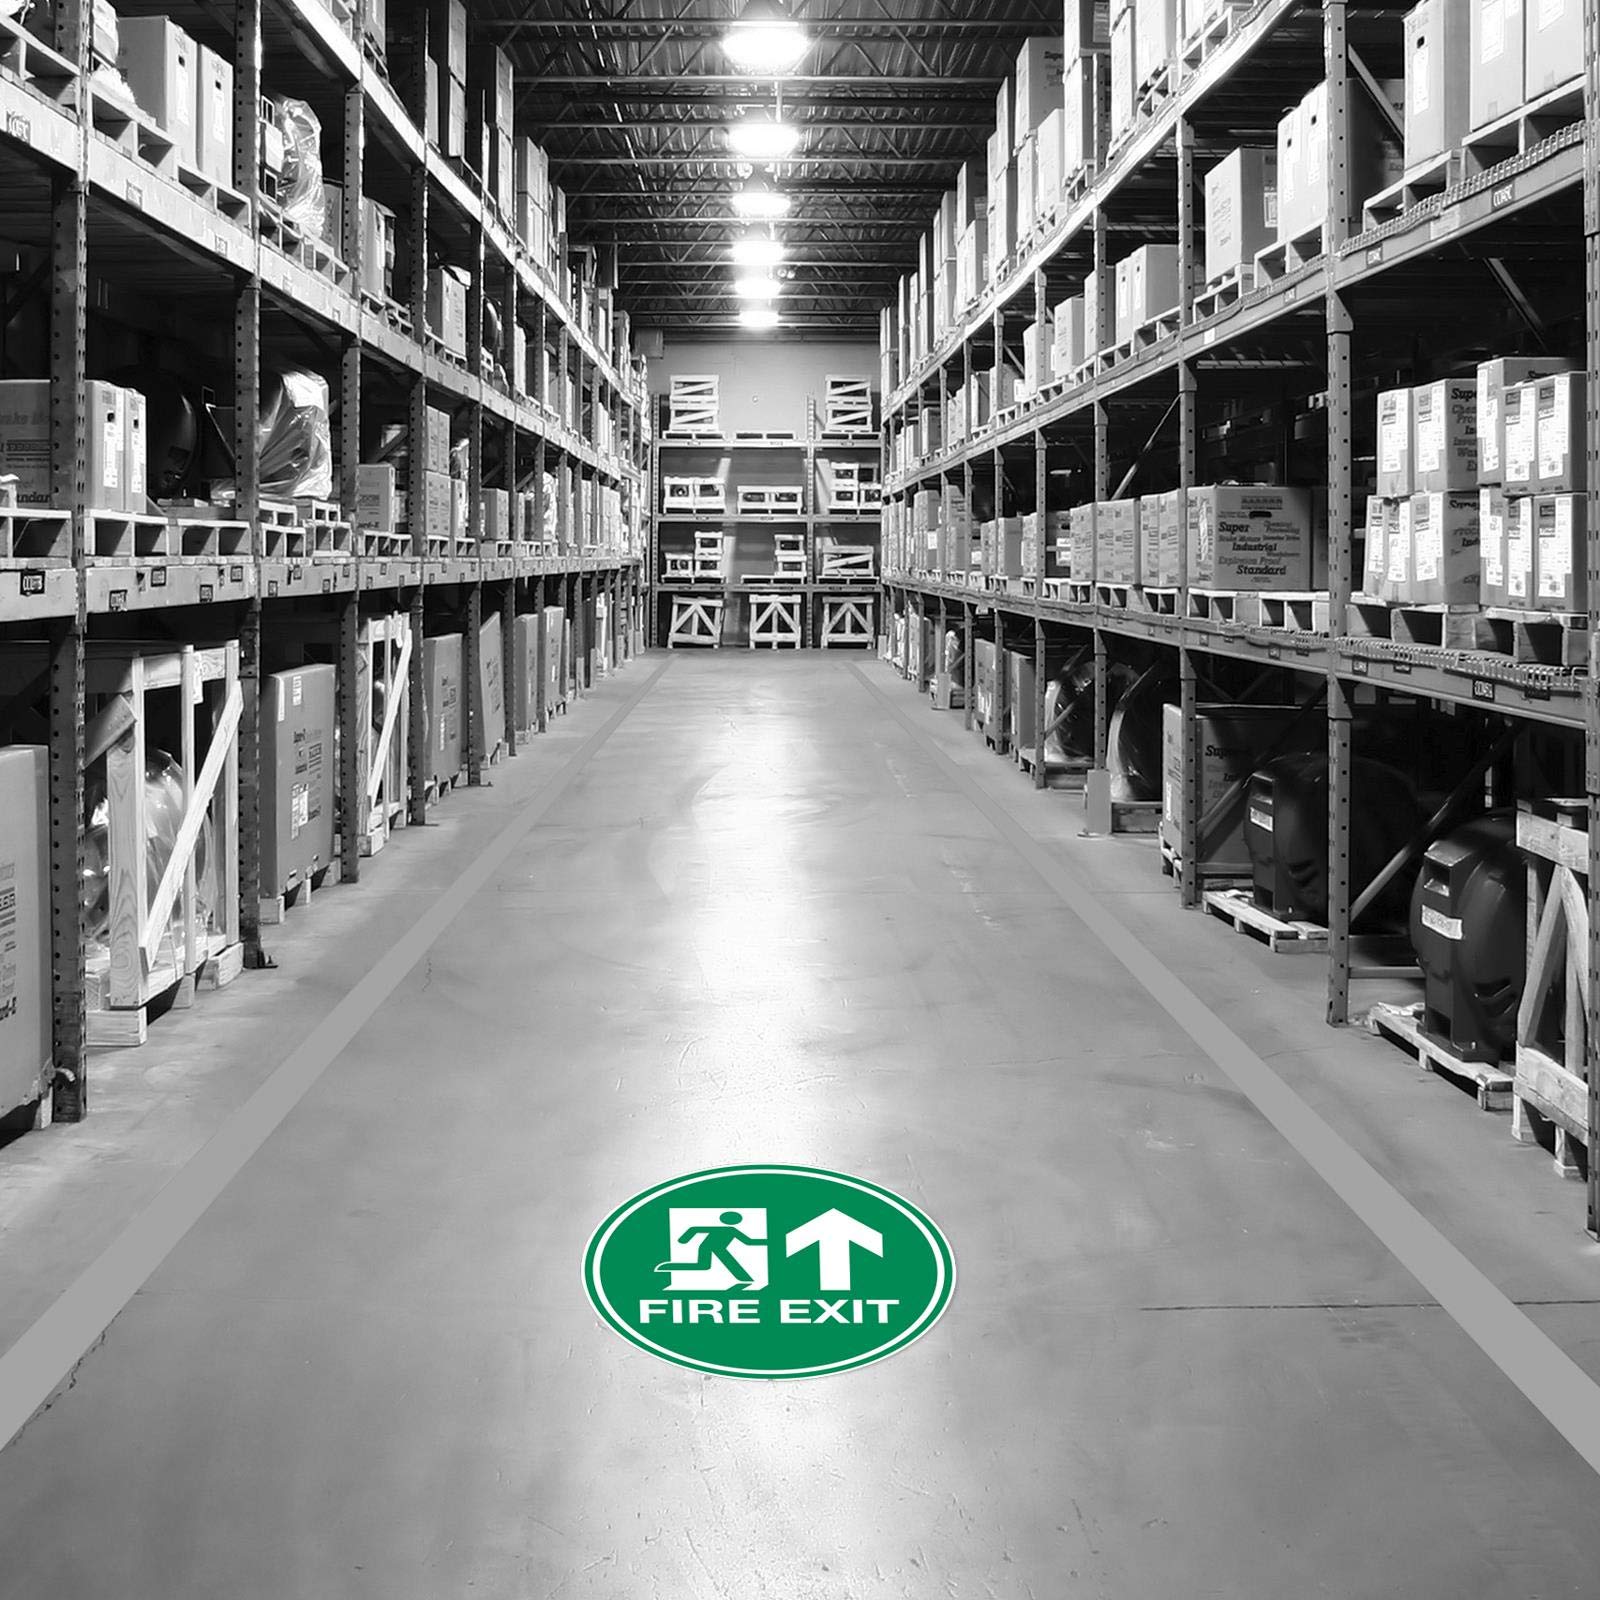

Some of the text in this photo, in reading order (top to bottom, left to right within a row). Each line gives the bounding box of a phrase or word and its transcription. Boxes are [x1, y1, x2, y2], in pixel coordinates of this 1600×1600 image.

[1218, 522, 1250, 535] Super
[1232, 542, 1278, 552] Industrial
[1236, 564, 1286, 575] Standard
[638, 1299, 900, 1324] FIRE EXIT
